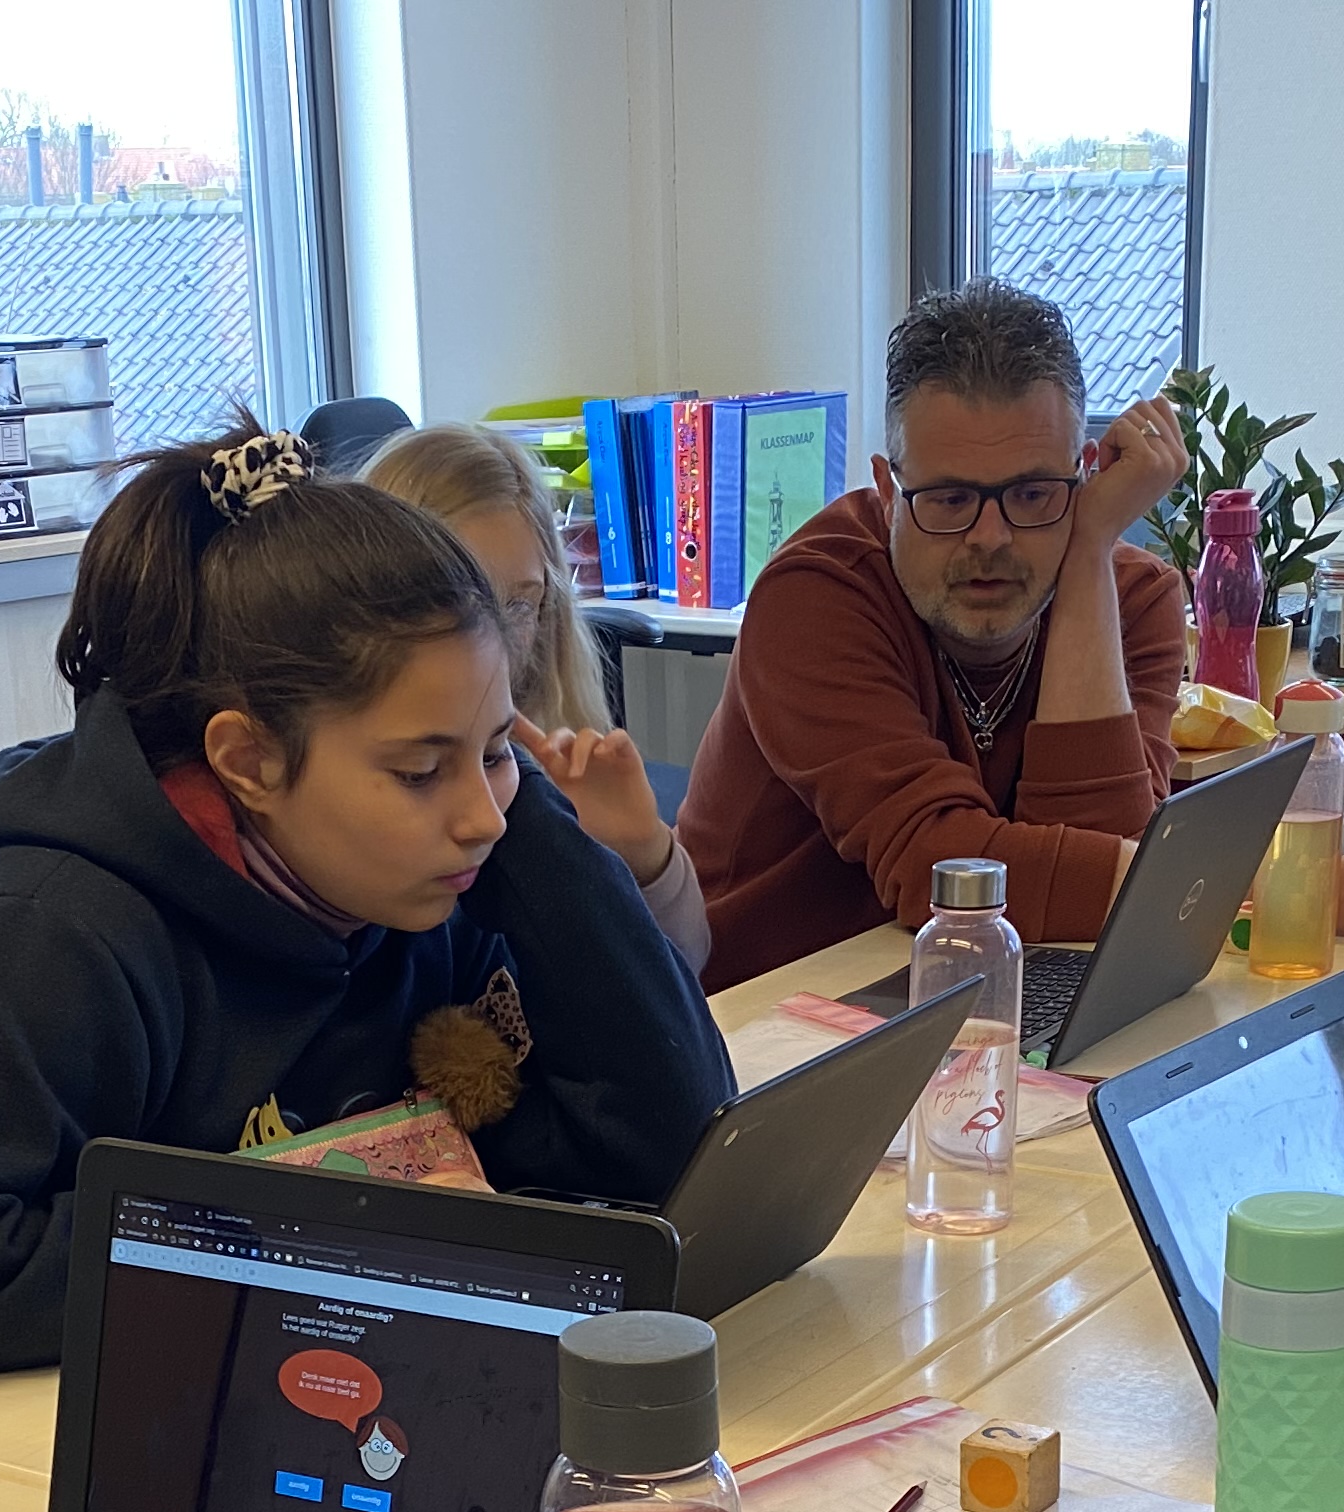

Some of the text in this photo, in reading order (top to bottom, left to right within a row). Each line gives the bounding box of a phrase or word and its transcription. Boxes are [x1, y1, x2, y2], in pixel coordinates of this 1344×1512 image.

[760, 431, 815, 450] KLASSENMAP
[608, 526, 616, 540] 6
[665, 531, 672, 545] 8
[934, 1088, 985, 1115] pigeons
[318, 1302, 394, 1323] Aardig of onaardig?
